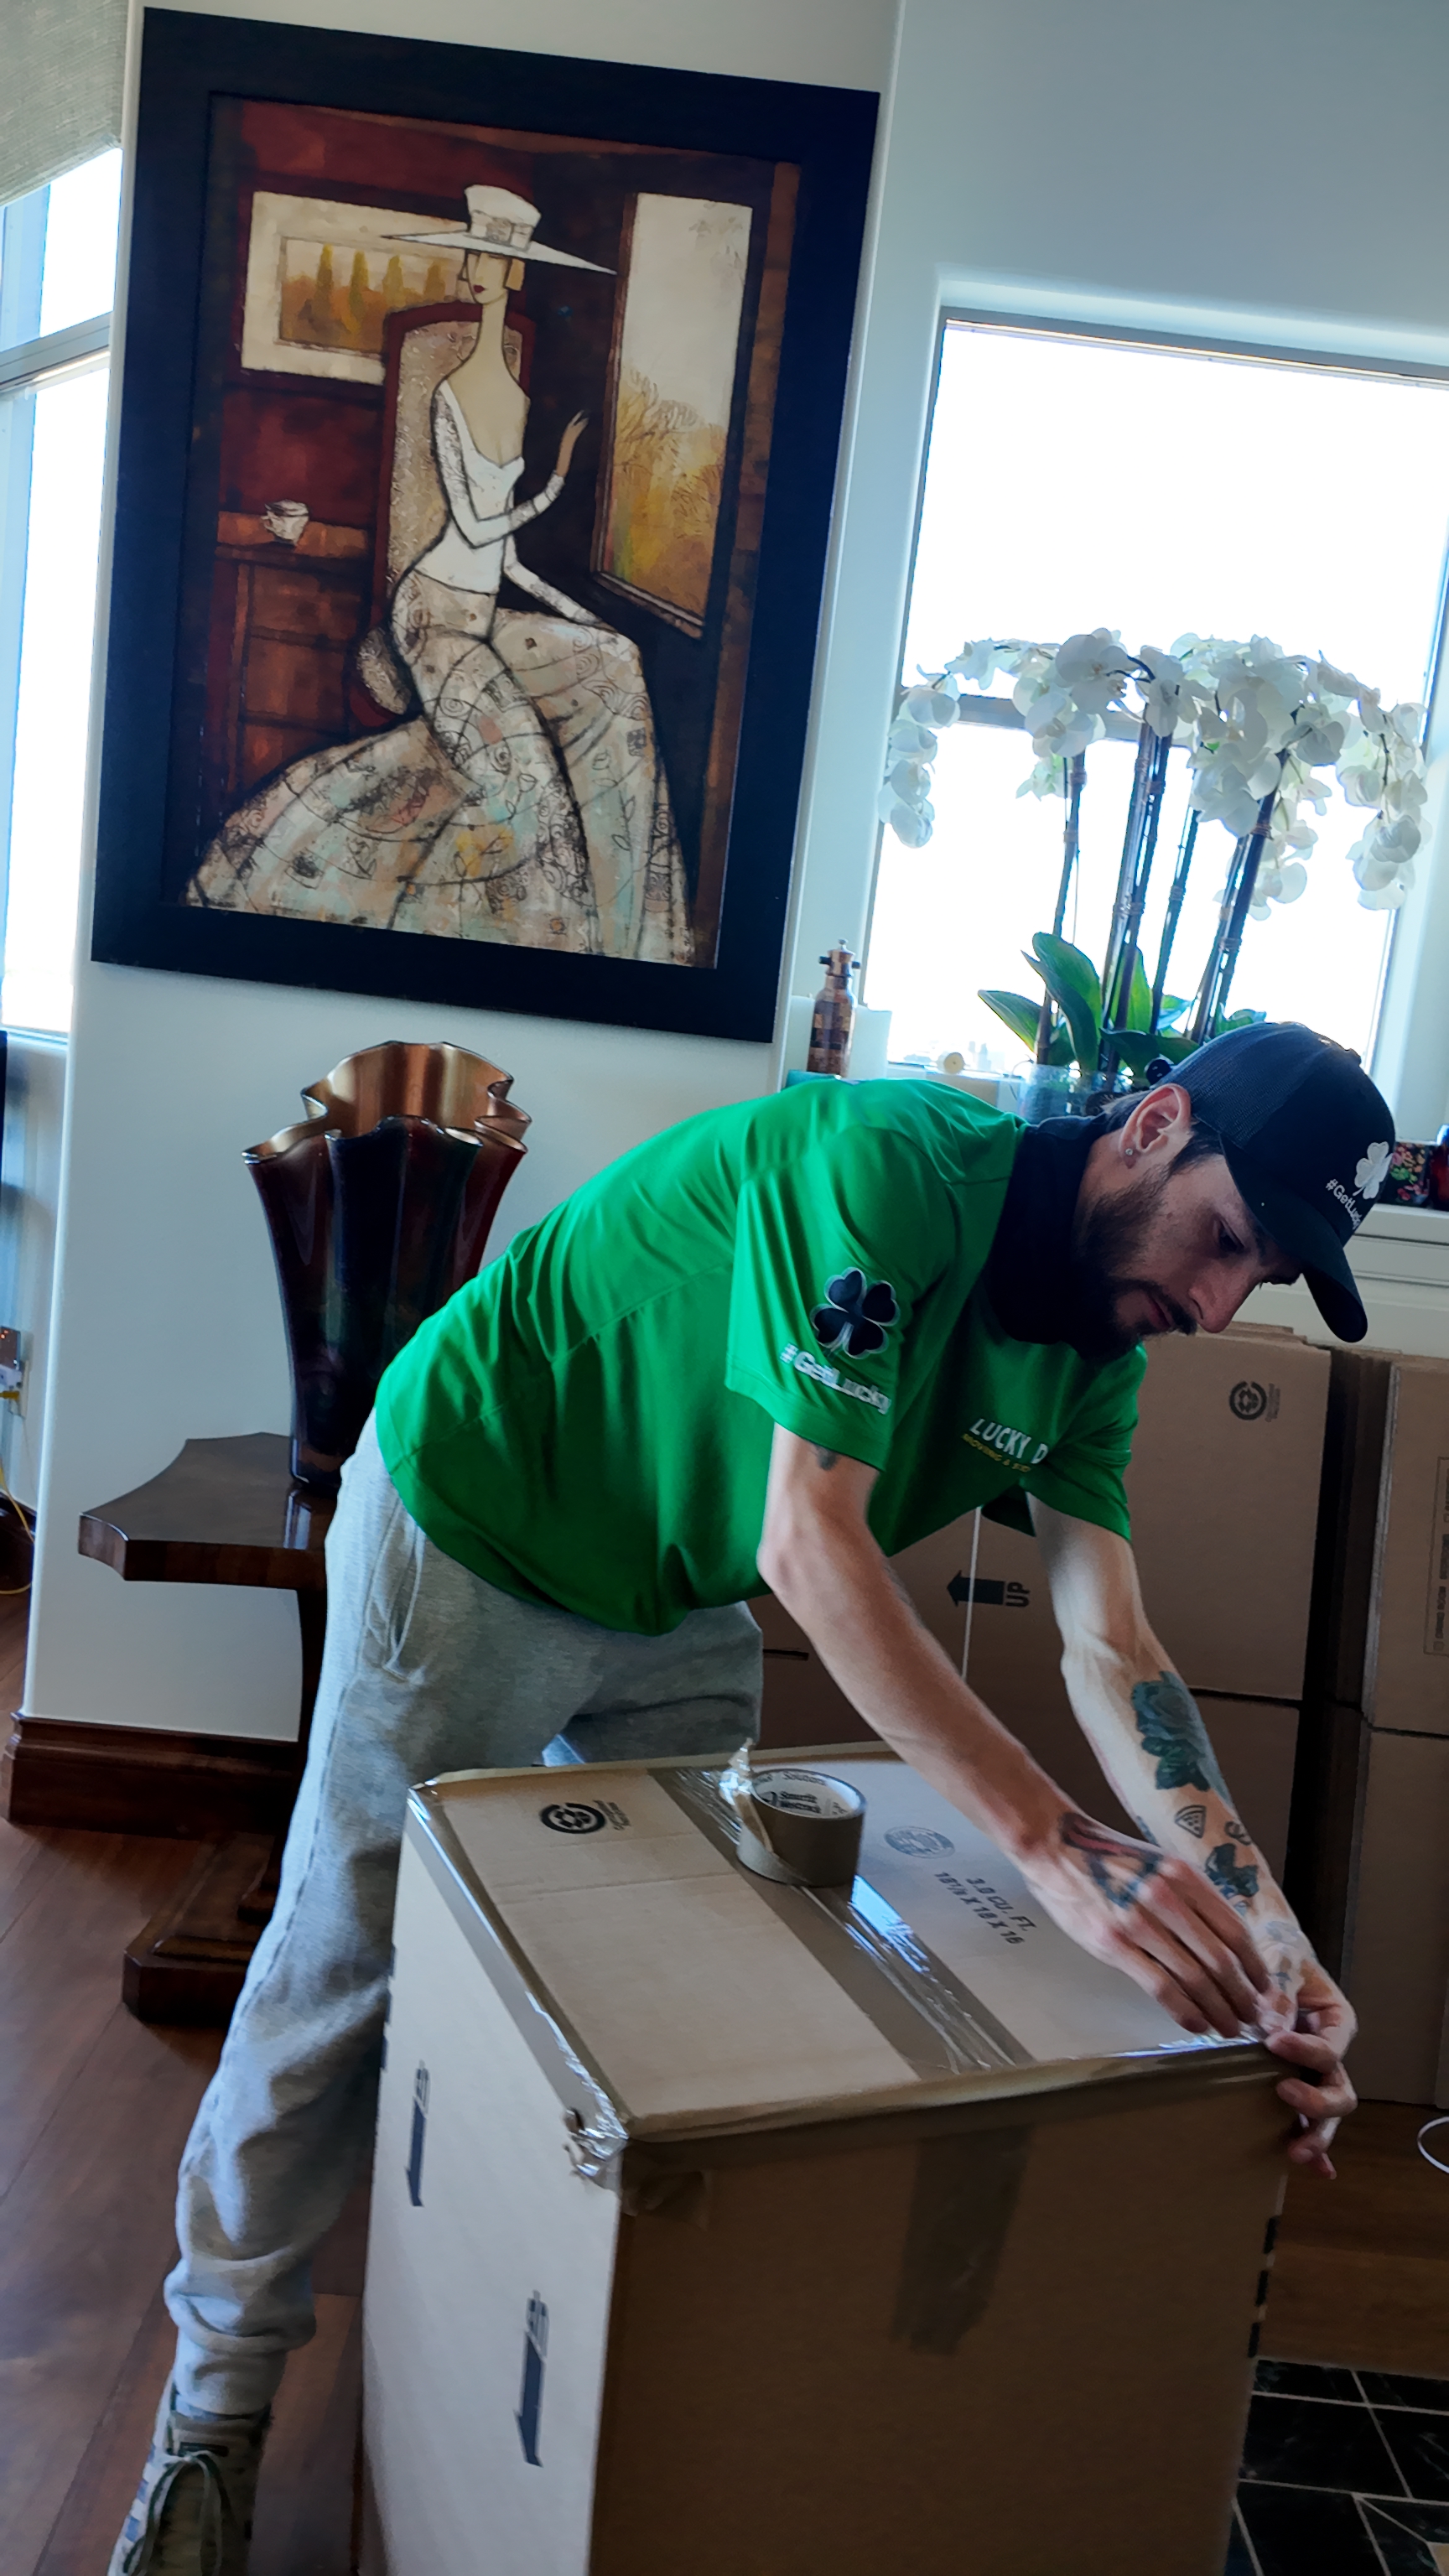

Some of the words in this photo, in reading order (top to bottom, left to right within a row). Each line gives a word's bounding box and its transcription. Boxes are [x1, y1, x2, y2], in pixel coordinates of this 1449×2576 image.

[969, 1418, 1031, 1459] LUCKY
[1031, 1443, 1048, 1464] D
[1005, 1581, 1031, 1607] UP
[1000, 1930, 1025, 1945] 16
